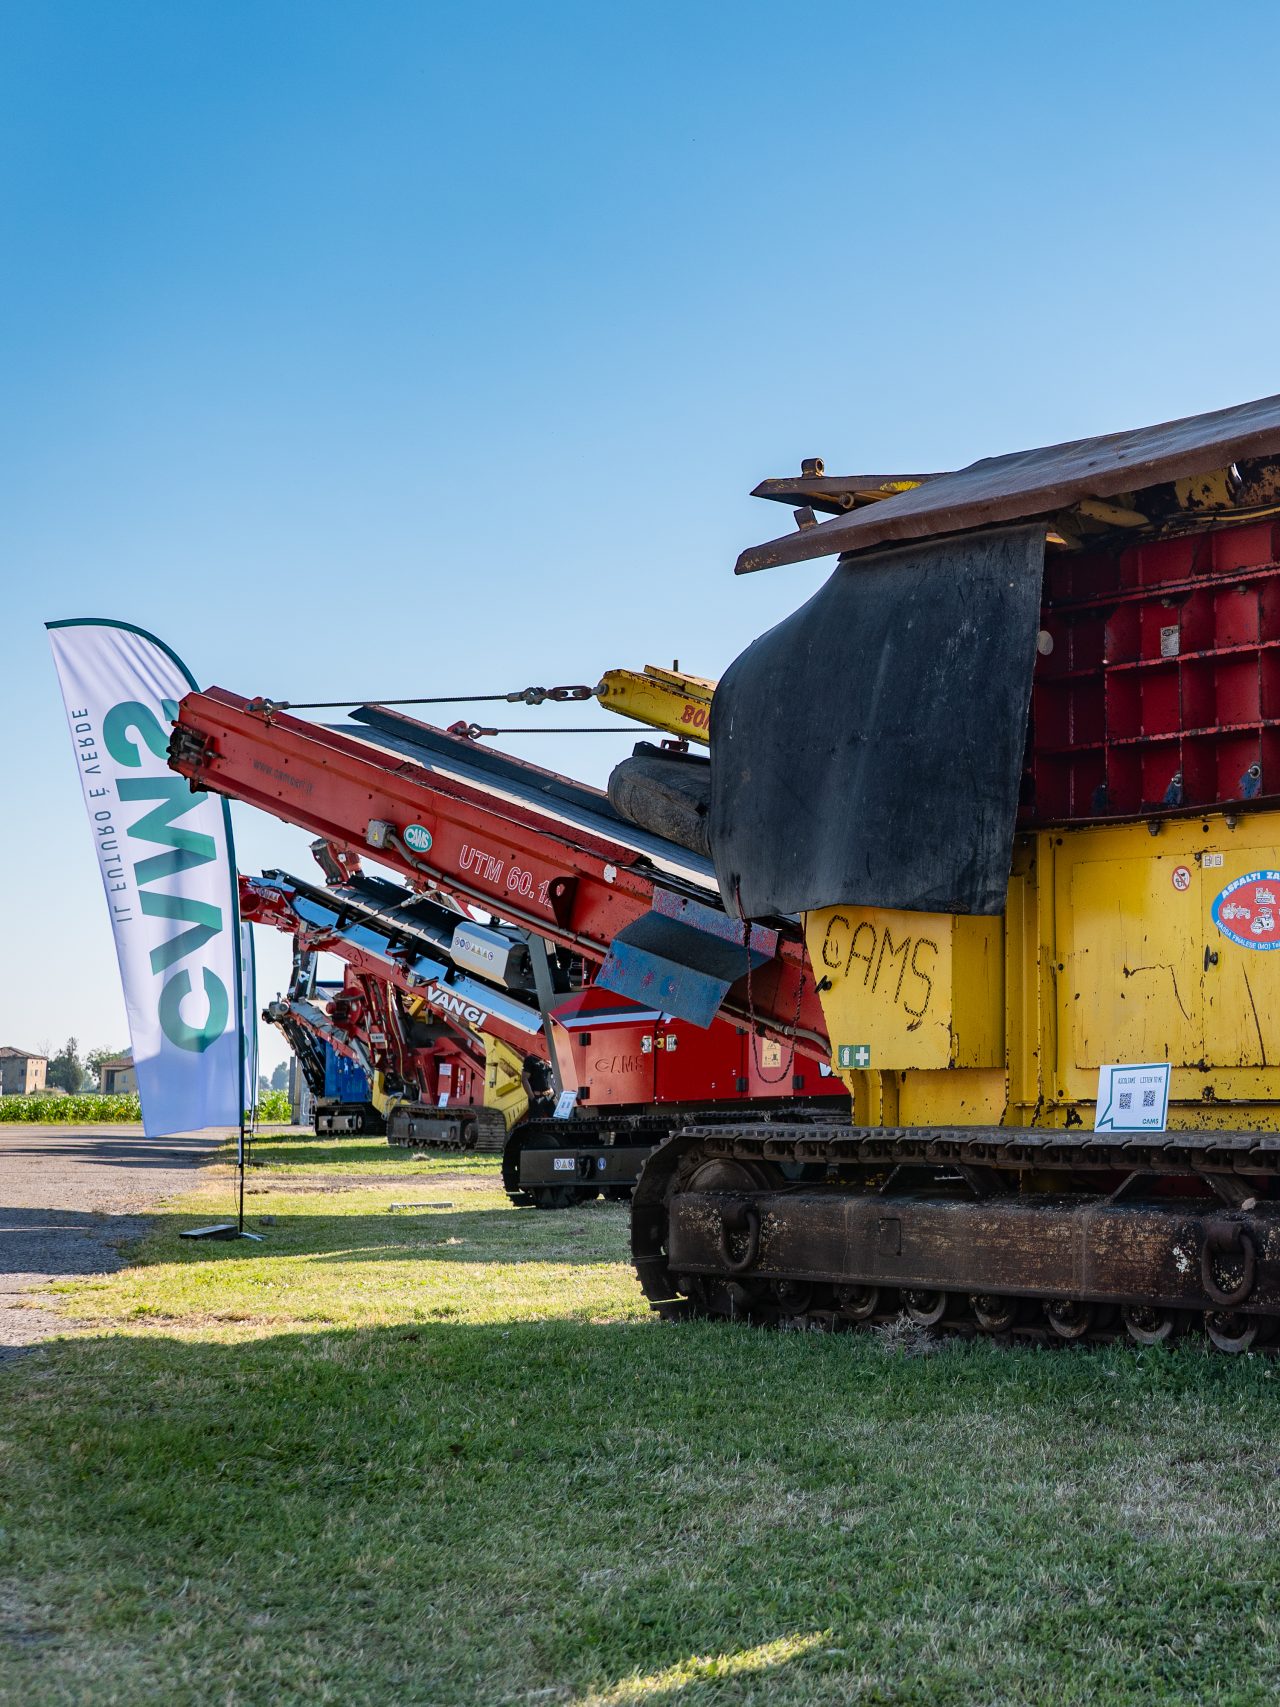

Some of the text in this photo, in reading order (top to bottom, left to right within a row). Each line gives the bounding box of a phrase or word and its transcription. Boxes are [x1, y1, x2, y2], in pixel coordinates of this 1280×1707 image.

[682, 704, 710, 731] BO
[405, 828, 429, 849] CAMS
[459, 845, 504, 884] UTM
[1221, 872, 1261, 899] ASFALTI
[1231, 932, 1257, 949] FINALESE
[822, 914, 939, 1018] CAMS
[427, 986, 487, 1028] VANGI
